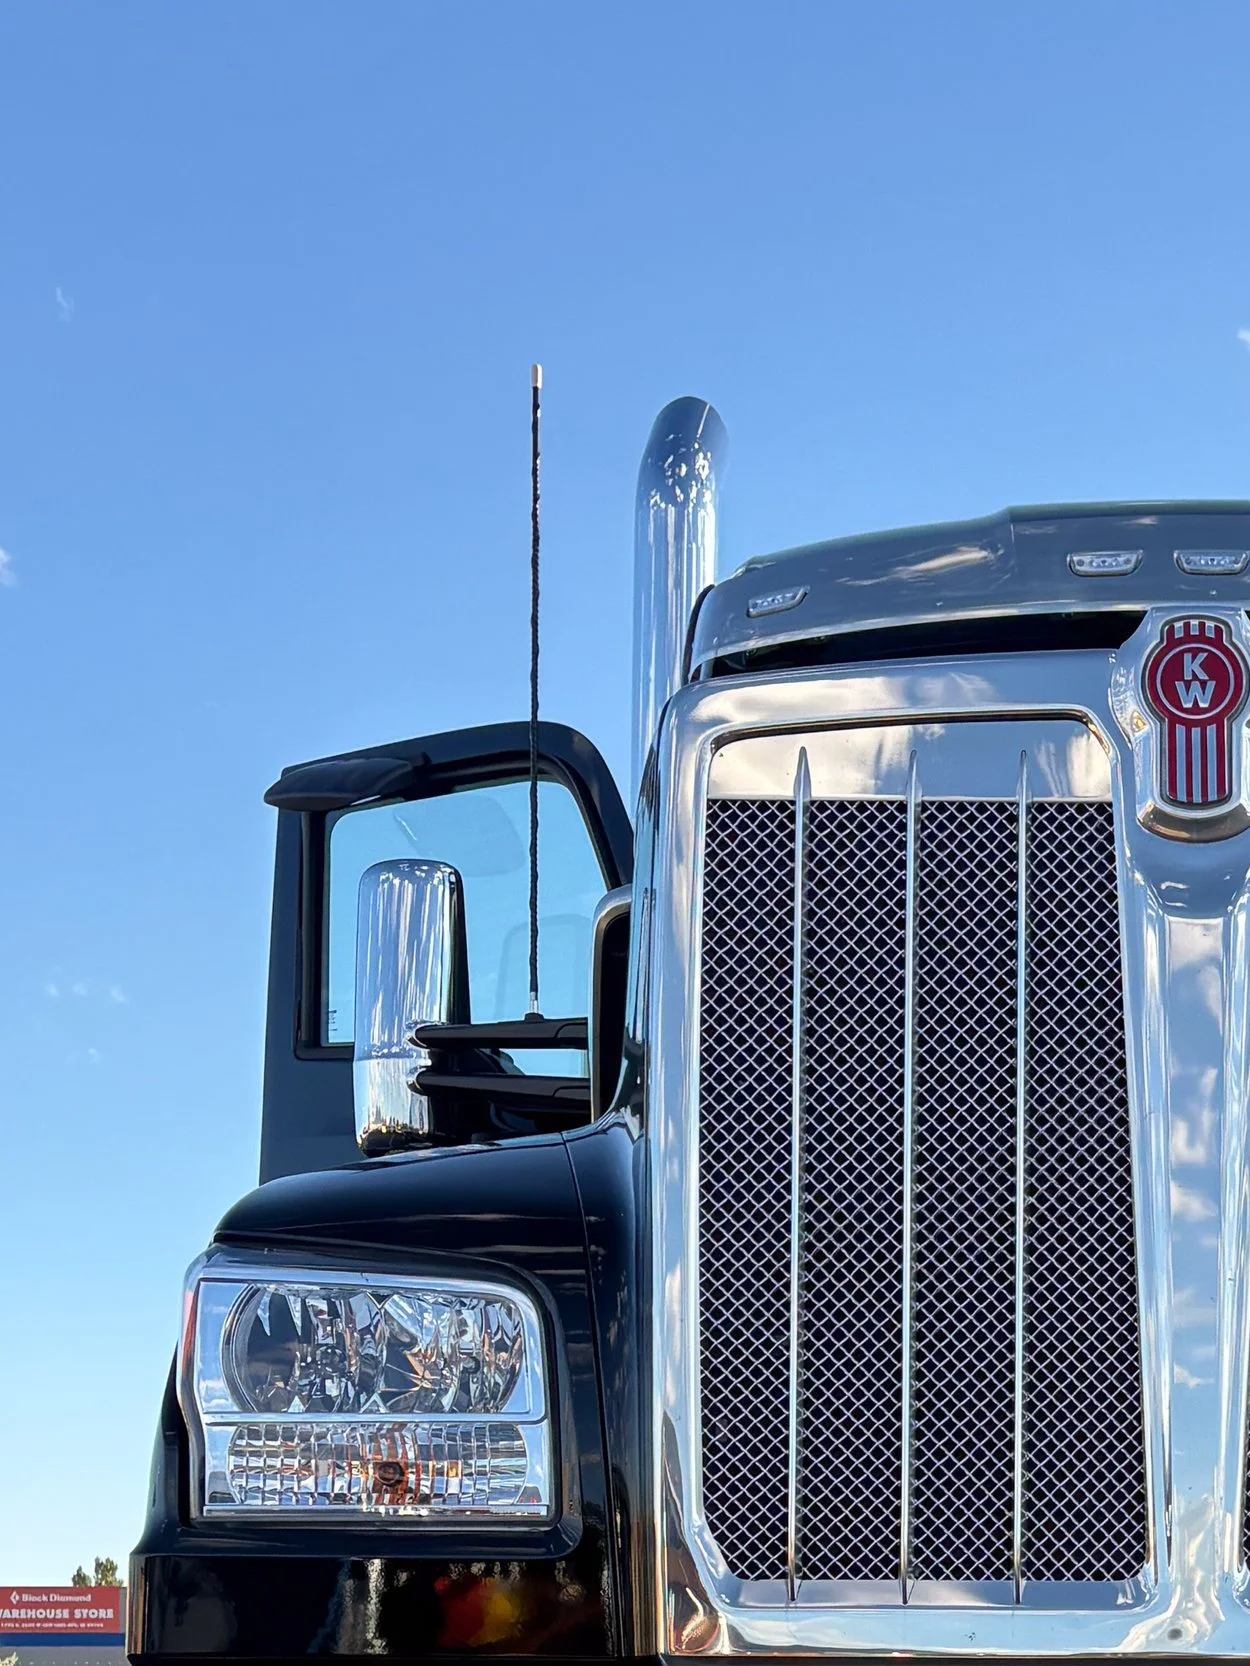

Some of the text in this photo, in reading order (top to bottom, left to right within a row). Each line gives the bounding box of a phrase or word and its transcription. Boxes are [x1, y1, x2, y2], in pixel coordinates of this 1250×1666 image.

[22, 1593, 92, 1602] Black Diamond
[0, 1608, 114, 1619] AREHOUSE STORE
